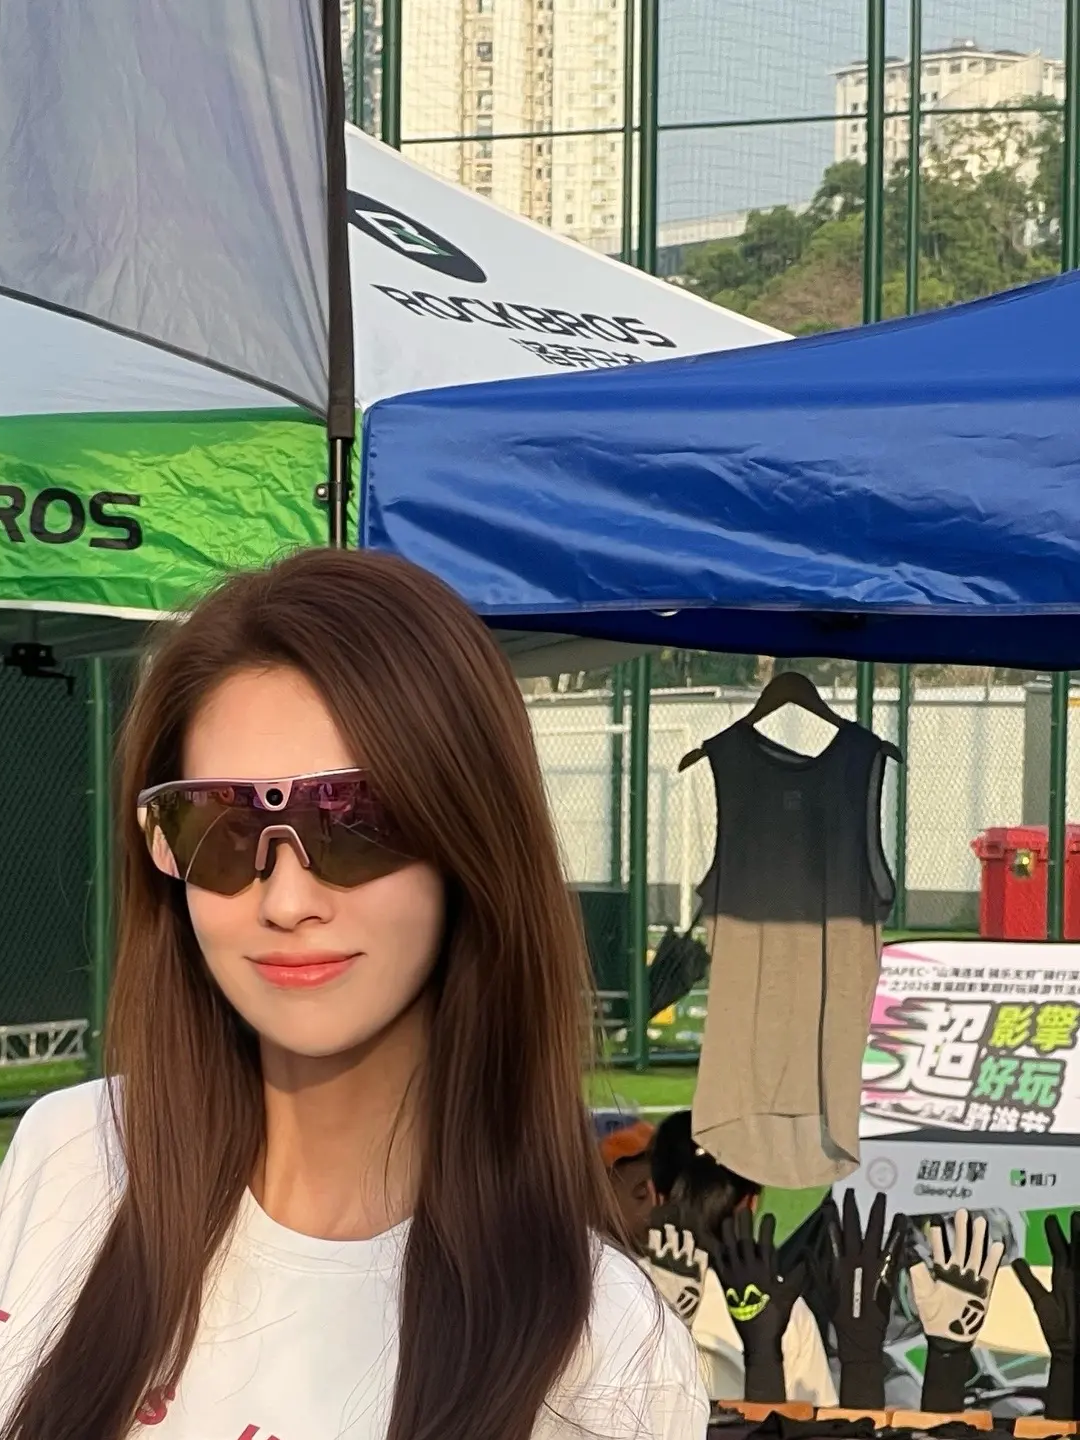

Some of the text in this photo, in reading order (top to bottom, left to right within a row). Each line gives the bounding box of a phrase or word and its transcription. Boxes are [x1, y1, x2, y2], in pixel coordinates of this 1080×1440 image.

[371, 284, 677, 348] ROCKBROS
[989, 1004, 1079, 1050] 影擎
[973, 1056, 1062, 1106] 好玩
[917, 1158, 988, 1183] 超影擎
